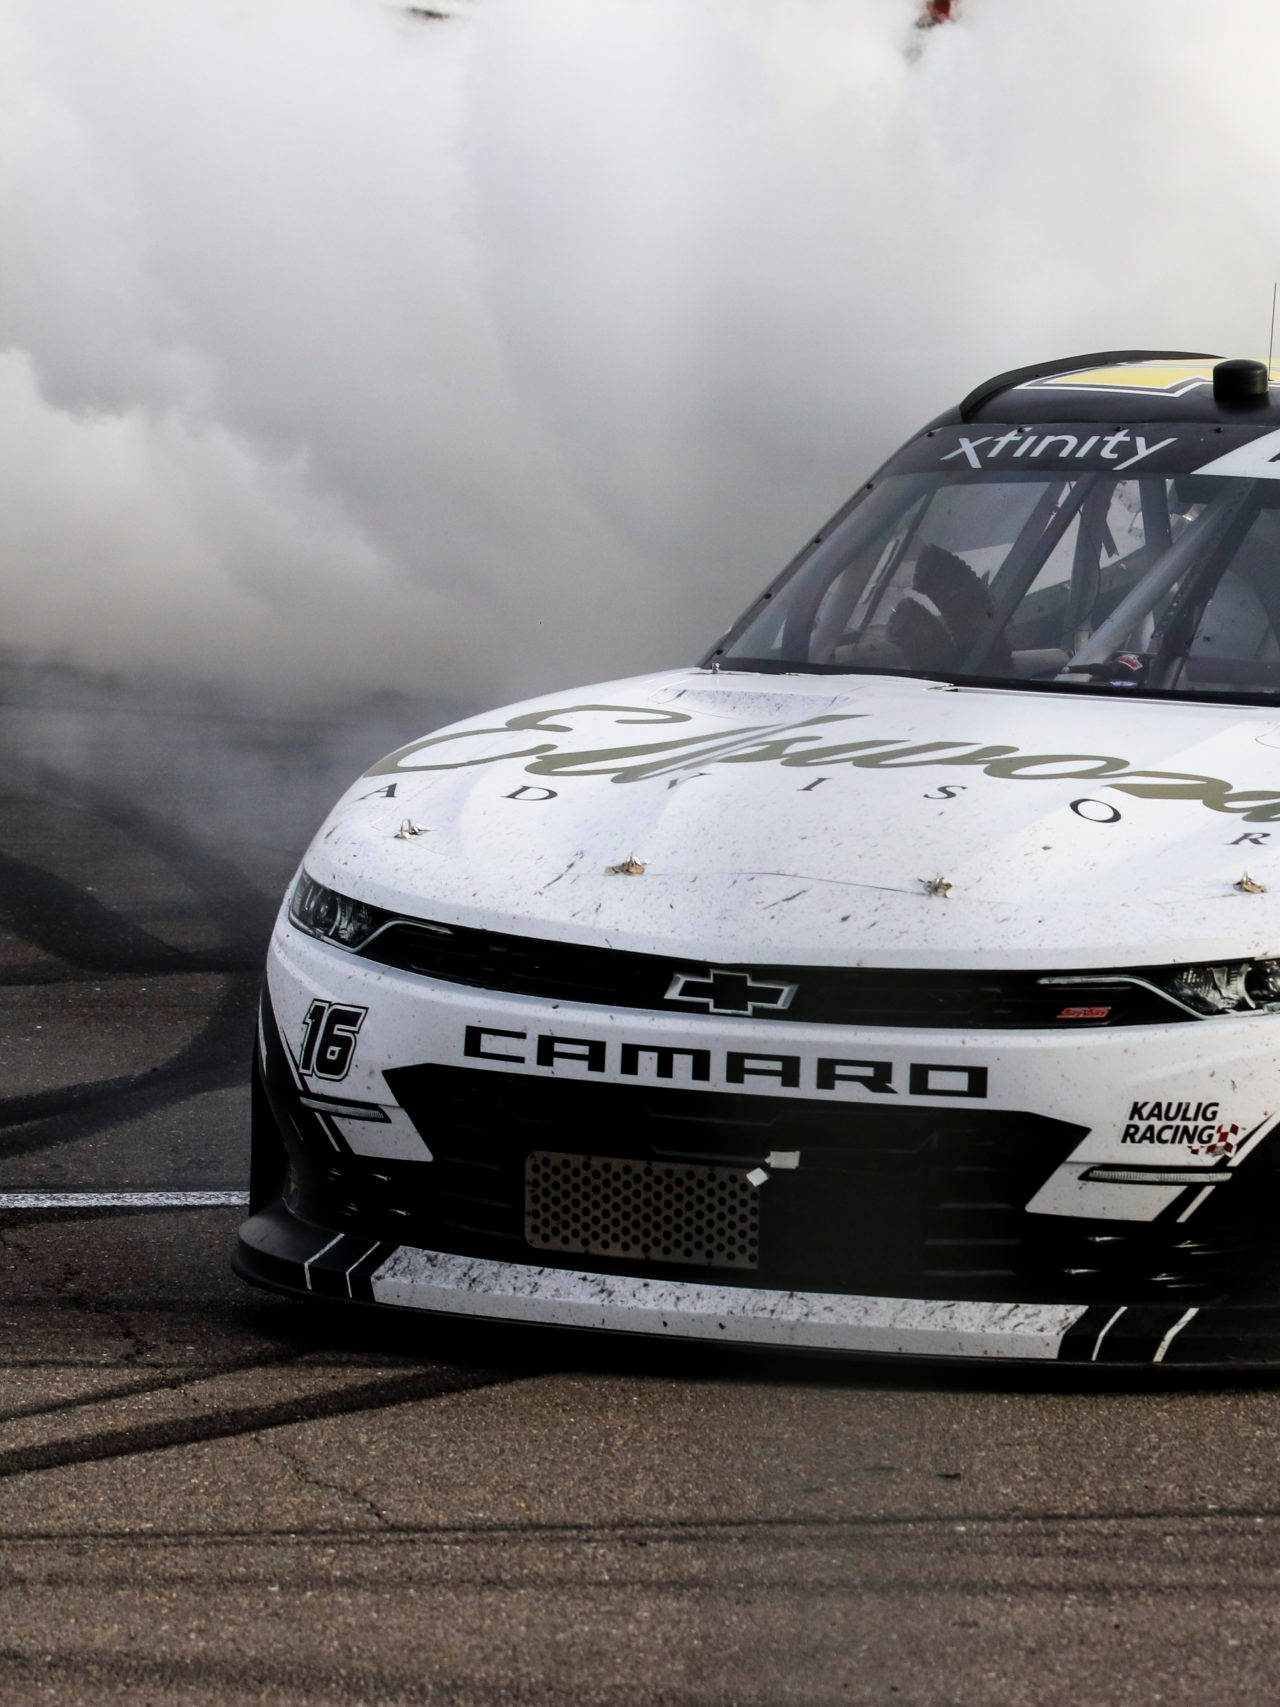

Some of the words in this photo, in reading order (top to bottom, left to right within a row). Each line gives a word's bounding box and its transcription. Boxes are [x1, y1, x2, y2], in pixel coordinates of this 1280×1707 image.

[940, 427, 1178, 470] xfinity
[299, 998, 369, 1082] 16
[464, 1025, 988, 1098] CAMARO
[1128, 1101, 1219, 1121] KAULIG
[1121, 1124, 1215, 1144] RACING
